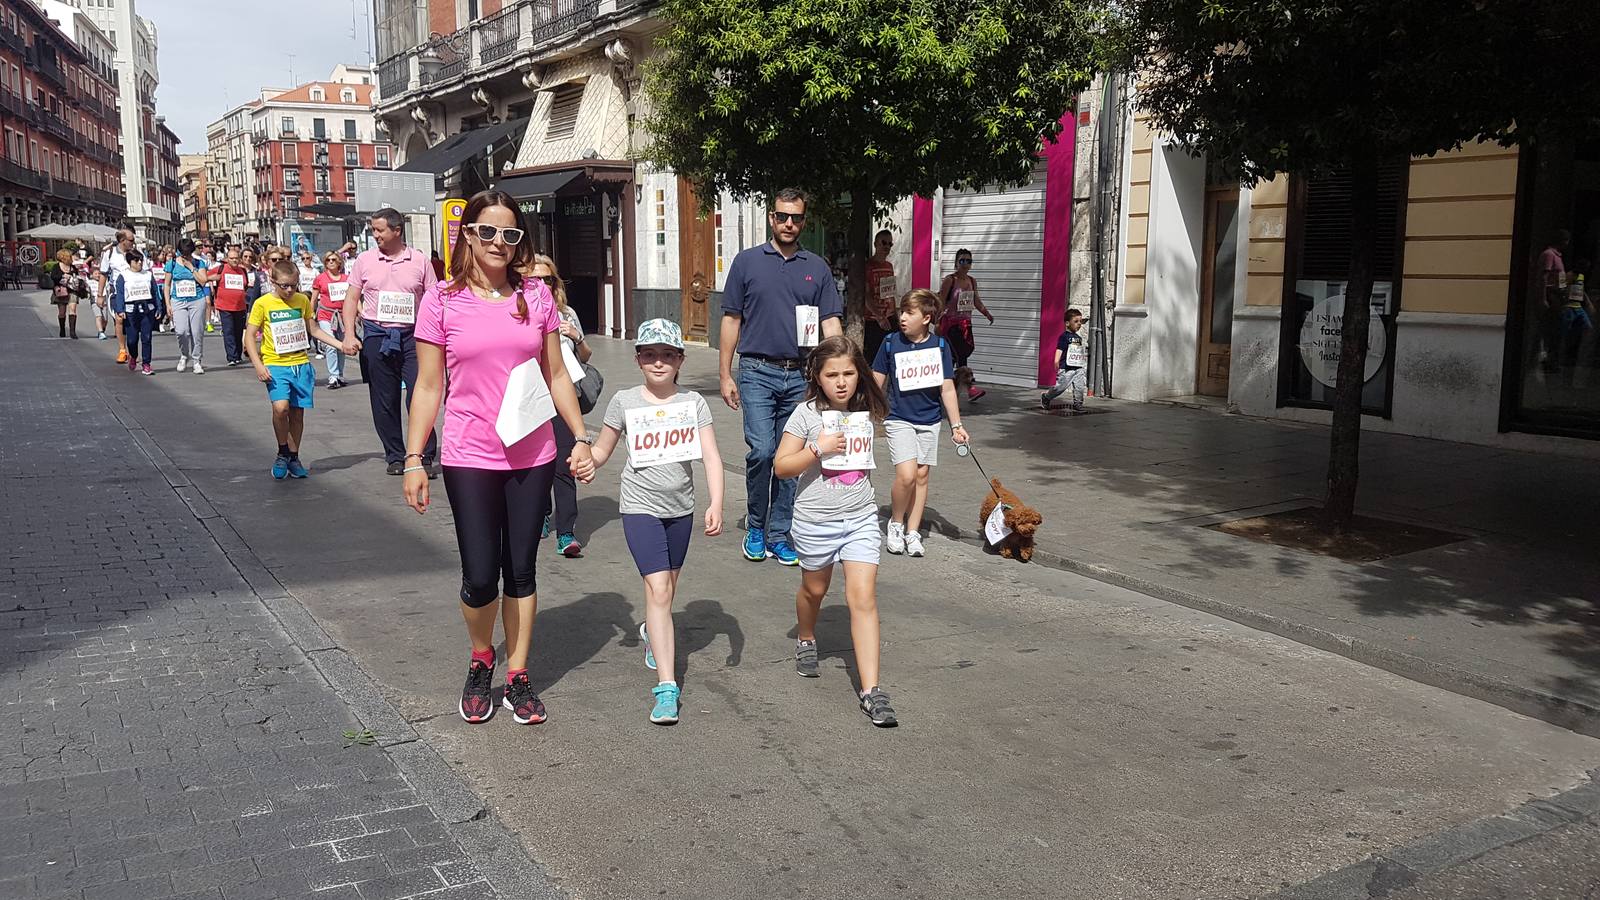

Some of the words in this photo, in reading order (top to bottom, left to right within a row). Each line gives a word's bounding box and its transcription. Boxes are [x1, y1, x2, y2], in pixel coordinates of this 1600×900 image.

[454, 206, 460, 216] 8
[901, 366, 918, 379] LOS
[920, 363, 940, 378] JOYS
[634, 431, 661, 451] LOS
[663, 426, 695, 449] JOYS
[848, 436, 872, 455] JOYS
